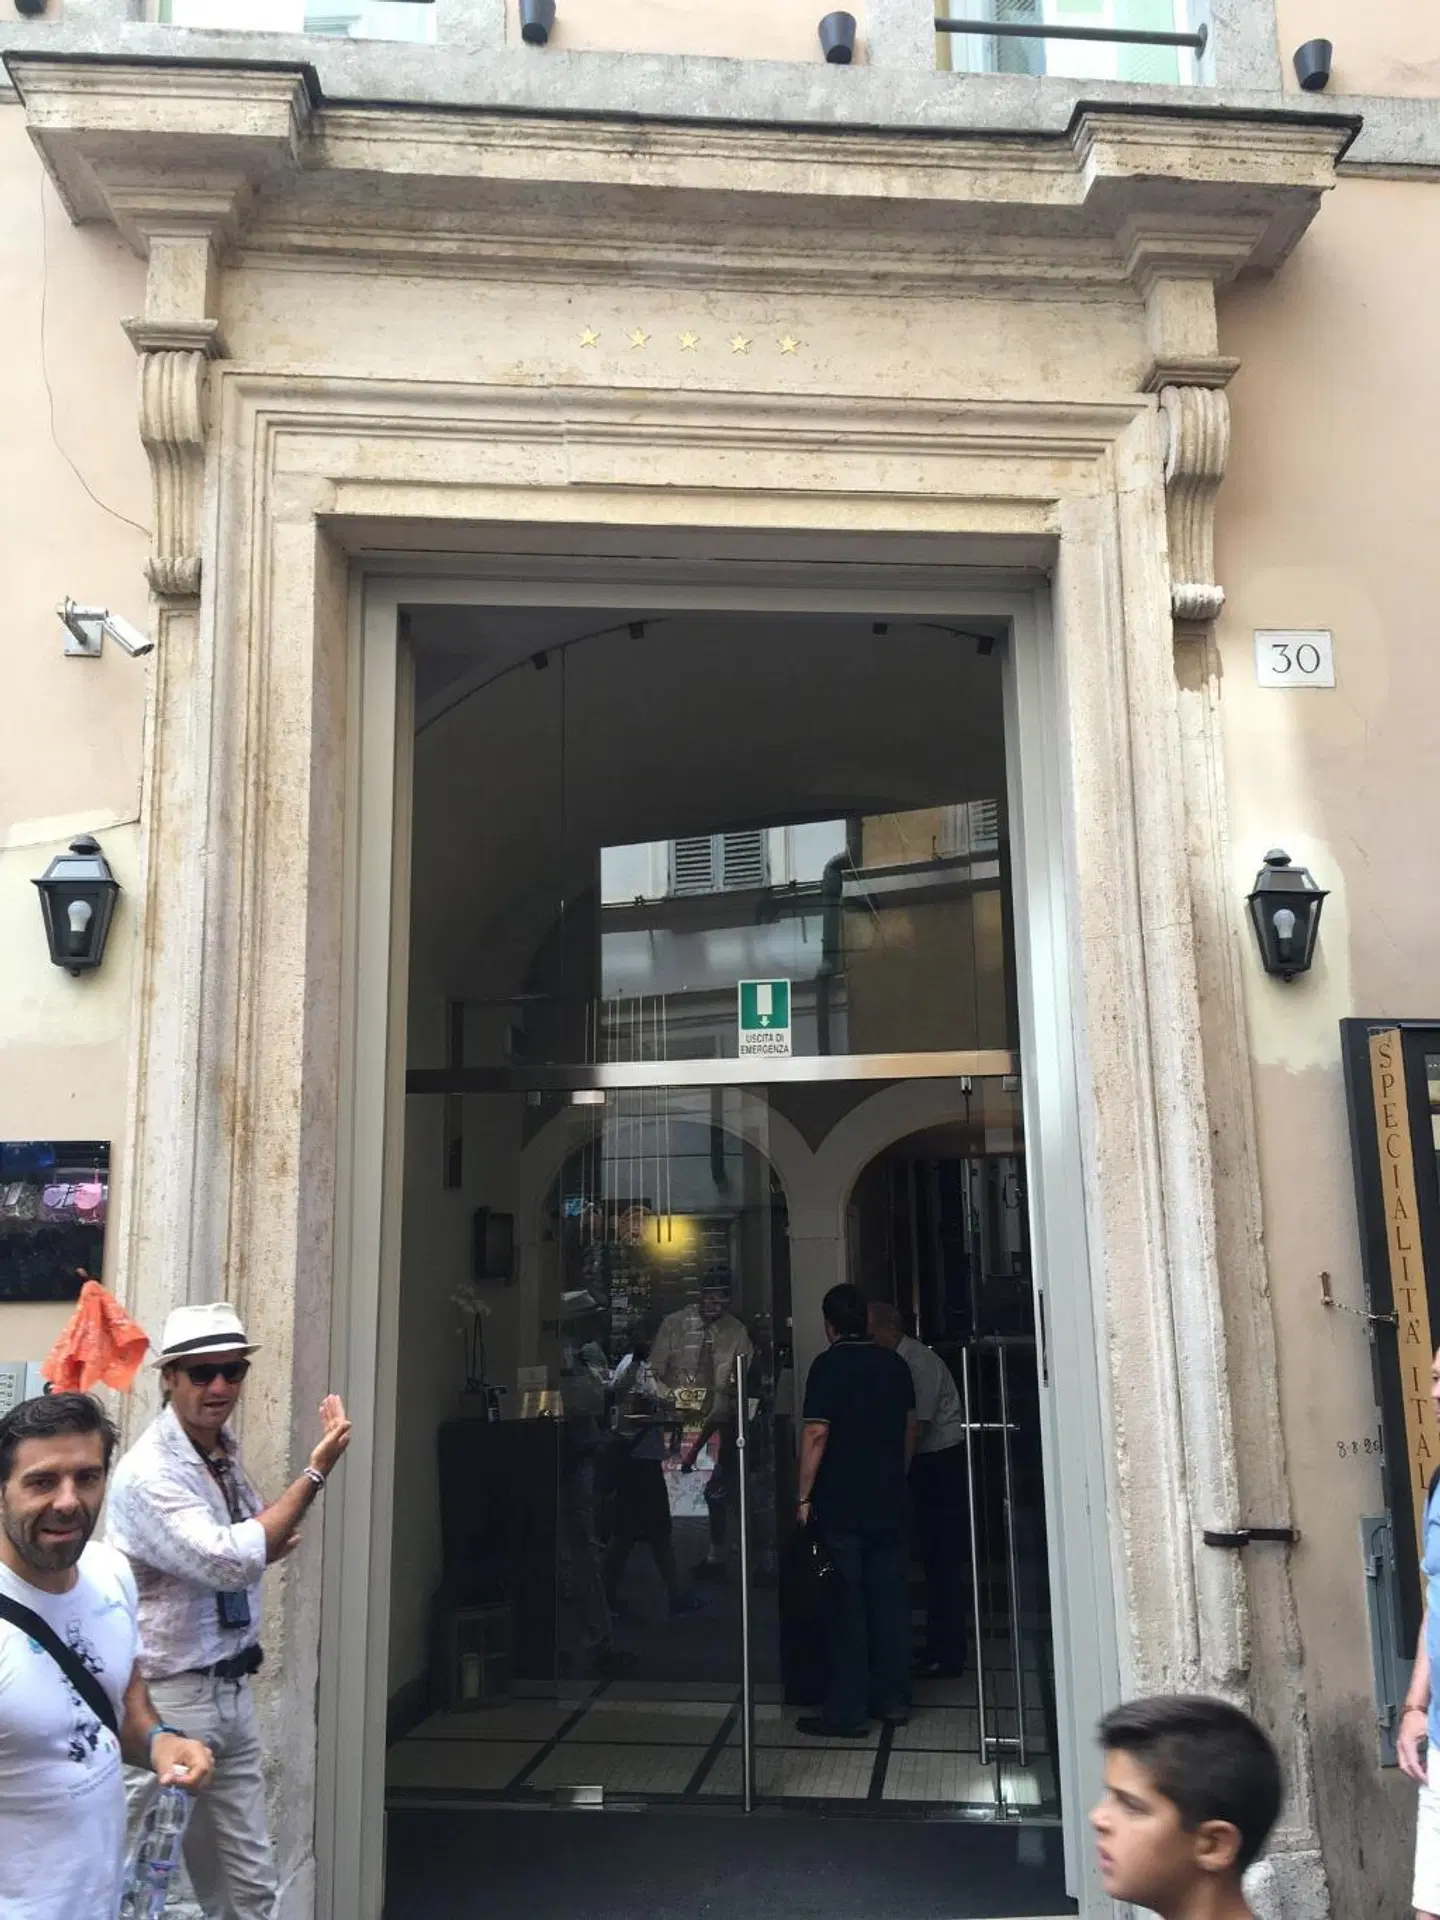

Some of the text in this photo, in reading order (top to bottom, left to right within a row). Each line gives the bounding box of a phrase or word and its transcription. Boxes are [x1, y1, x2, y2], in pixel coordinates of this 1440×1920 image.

[1272, 643, 1320, 674] 30
[745, 1033, 785, 1044] USCITA DI
[740, 1044, 789, 1055] EMERGENZA
